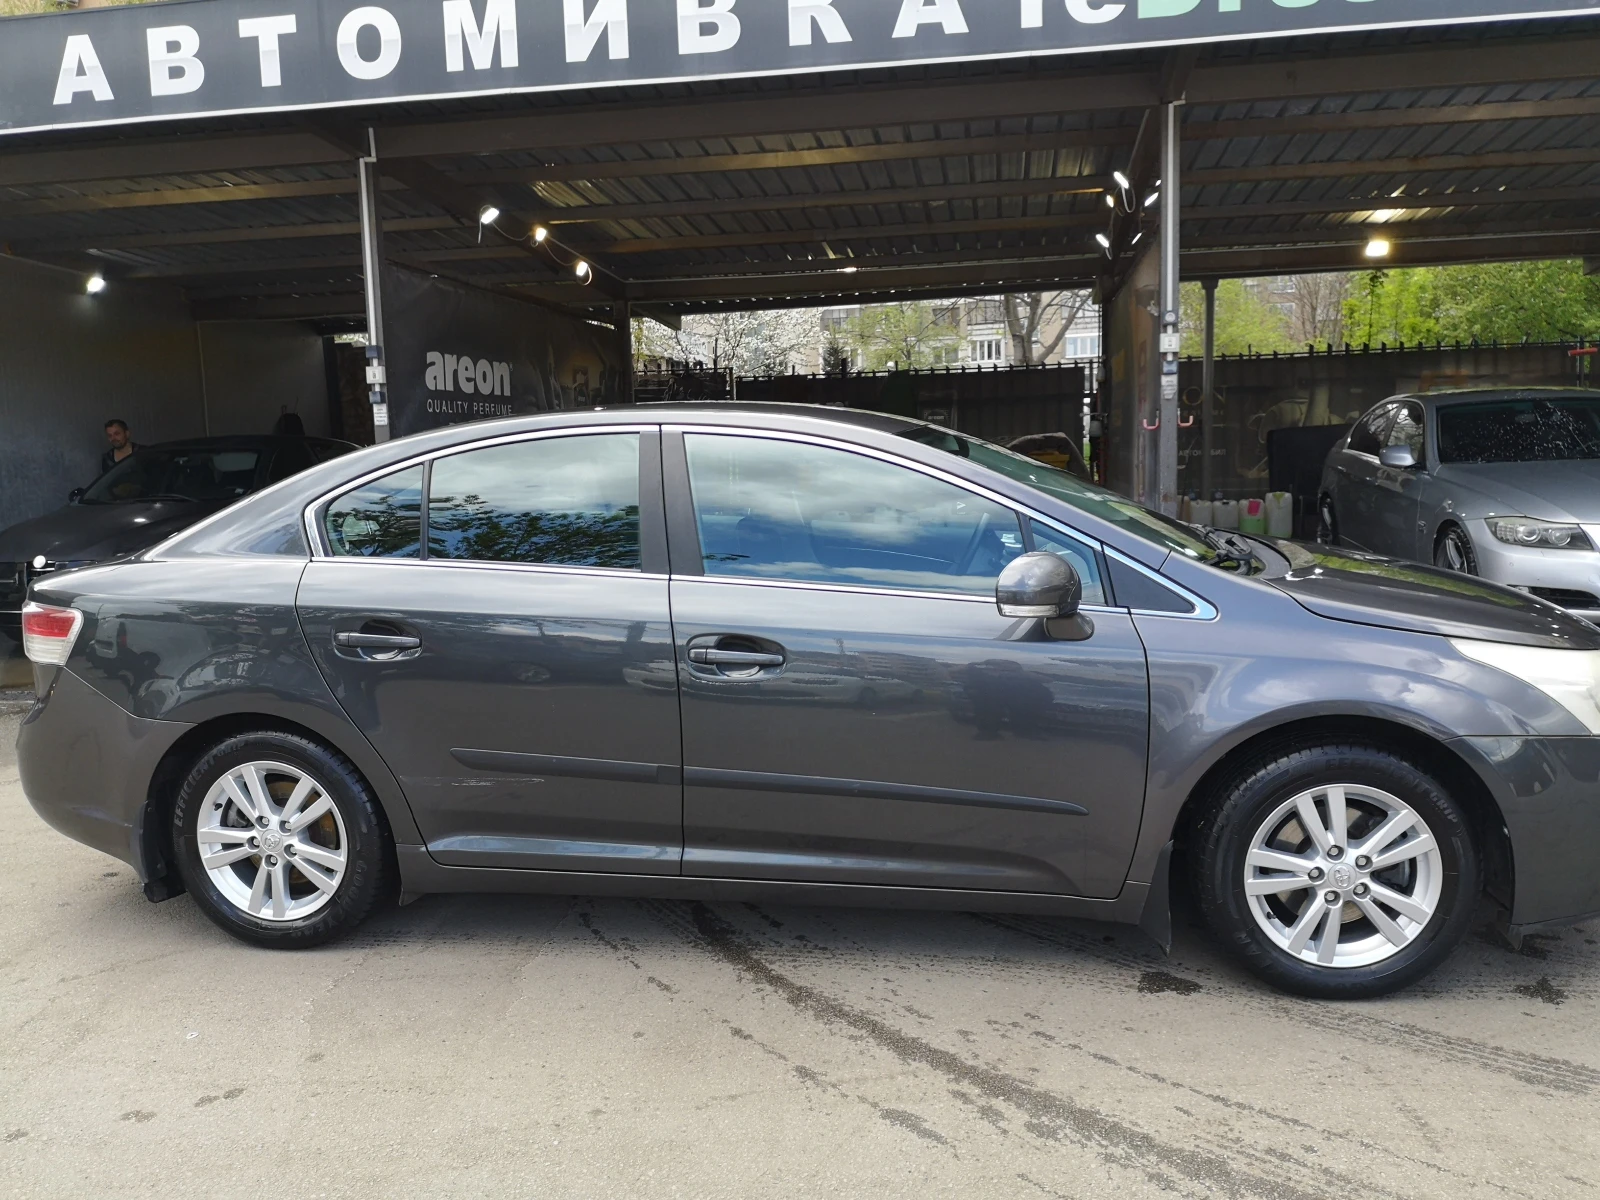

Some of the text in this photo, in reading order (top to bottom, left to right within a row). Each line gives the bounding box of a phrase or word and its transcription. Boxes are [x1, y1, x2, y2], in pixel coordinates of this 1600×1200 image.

[425, 351, 511, 396] areon
[426, 398, 512, 416] QUALITY PERFUME
